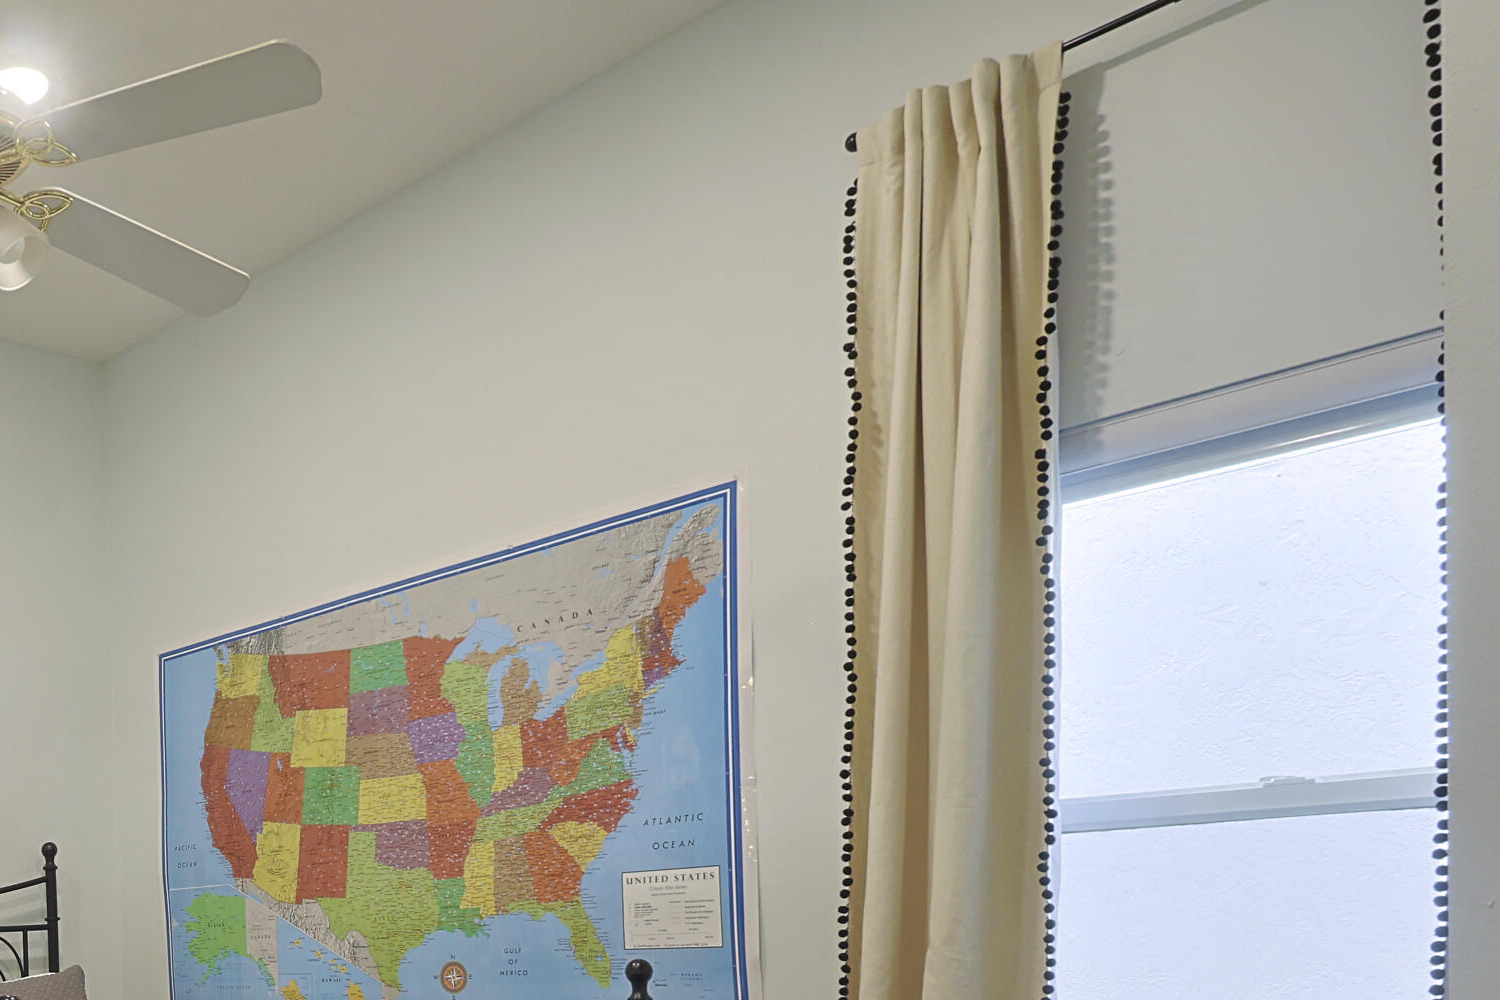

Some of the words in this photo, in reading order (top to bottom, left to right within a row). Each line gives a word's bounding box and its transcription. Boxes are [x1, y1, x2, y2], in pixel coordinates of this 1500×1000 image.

[517, 607, 593, 633] CANADA
[643, 812, 705, 827] ATLANTIC
[174, 843, 197, 852] PACIFIC
[652, 839, 696, 851] OCEAN
[177, 860, 198, 869] OCEAN
[626, 874, 669, 885] UNITED
[673, 871, 716, 882] STATES
[503, 947, 522, 955] GULF
[508, 958, 519, 966] OF
[499, 969, 529, 977] MEXICO
